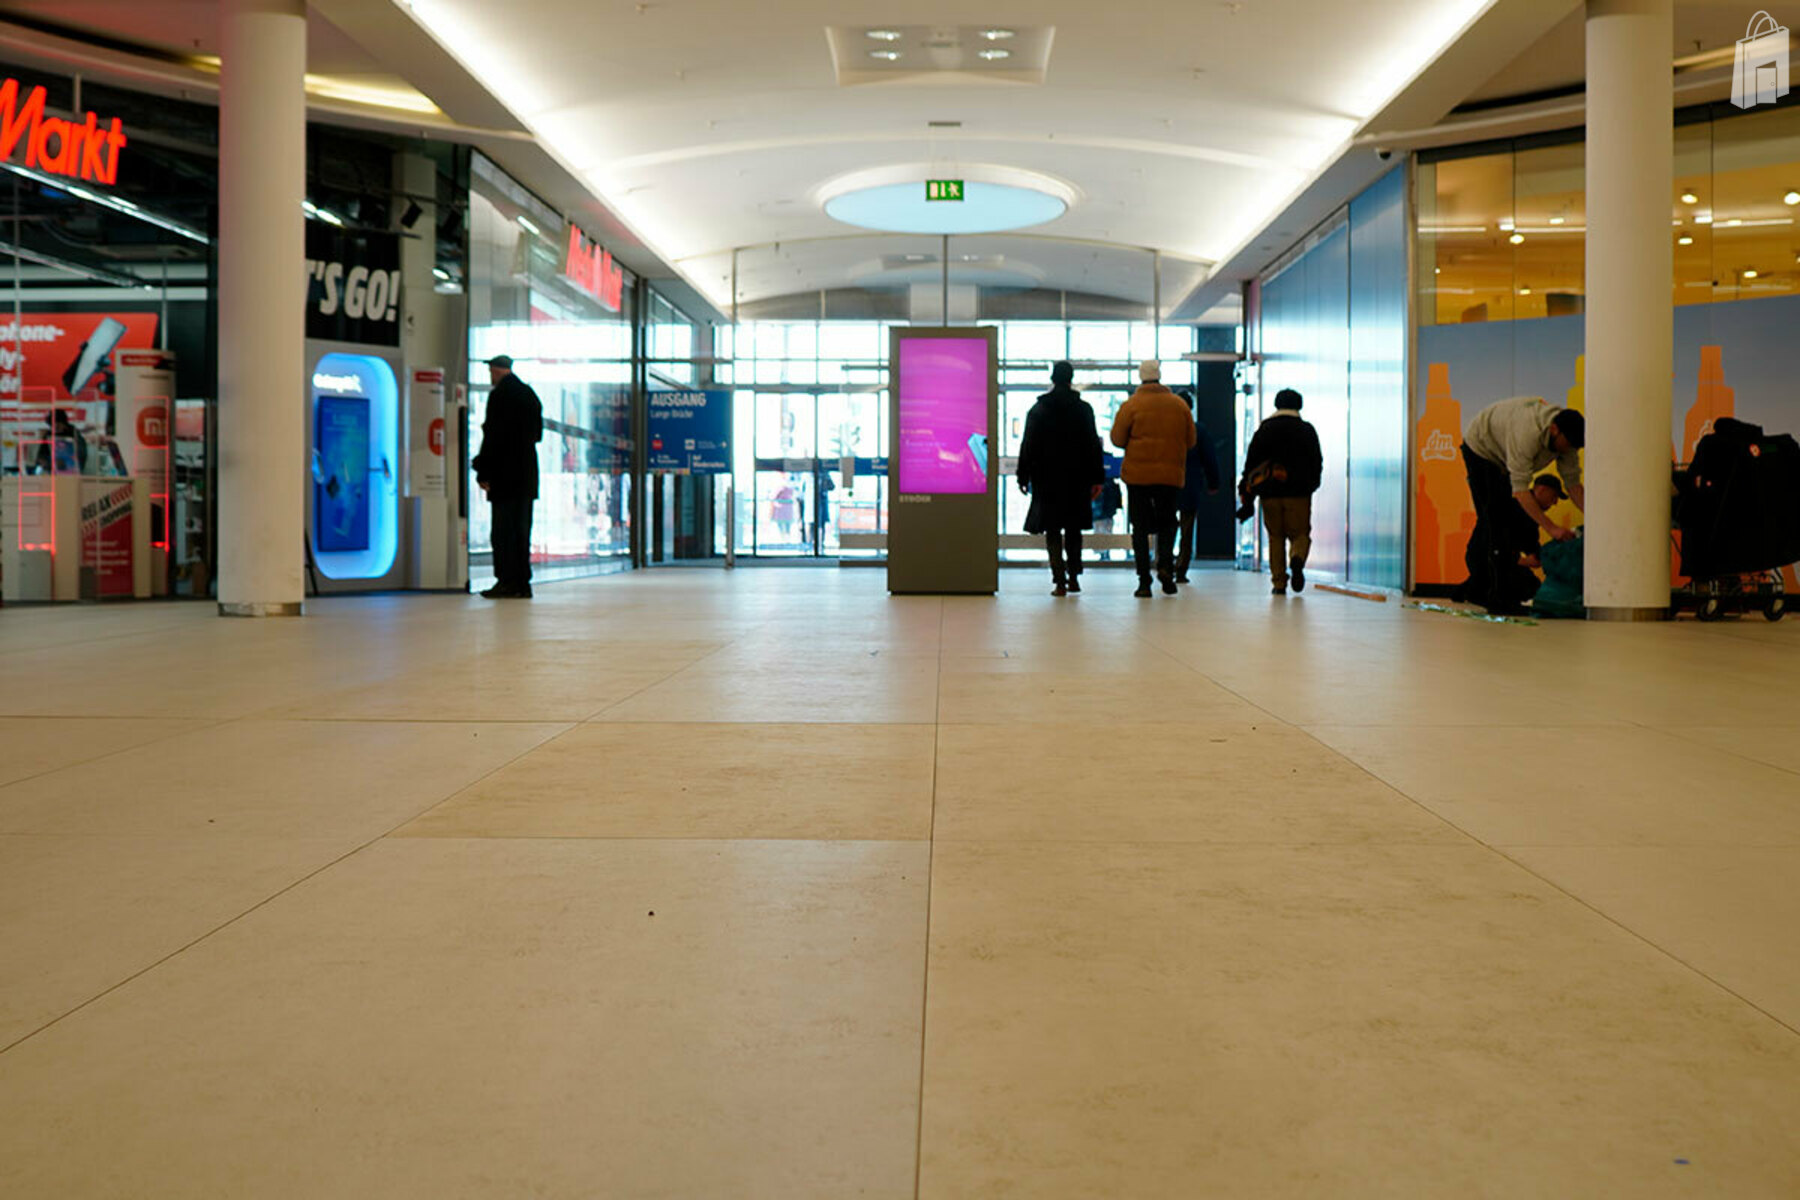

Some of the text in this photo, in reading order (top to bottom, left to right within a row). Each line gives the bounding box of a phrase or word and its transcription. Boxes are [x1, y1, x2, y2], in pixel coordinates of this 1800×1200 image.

[0, 78, 127, 185] Markt
[344, 265, 400, 322] GO!
[650, 391, 707, 407] AUSGANG
